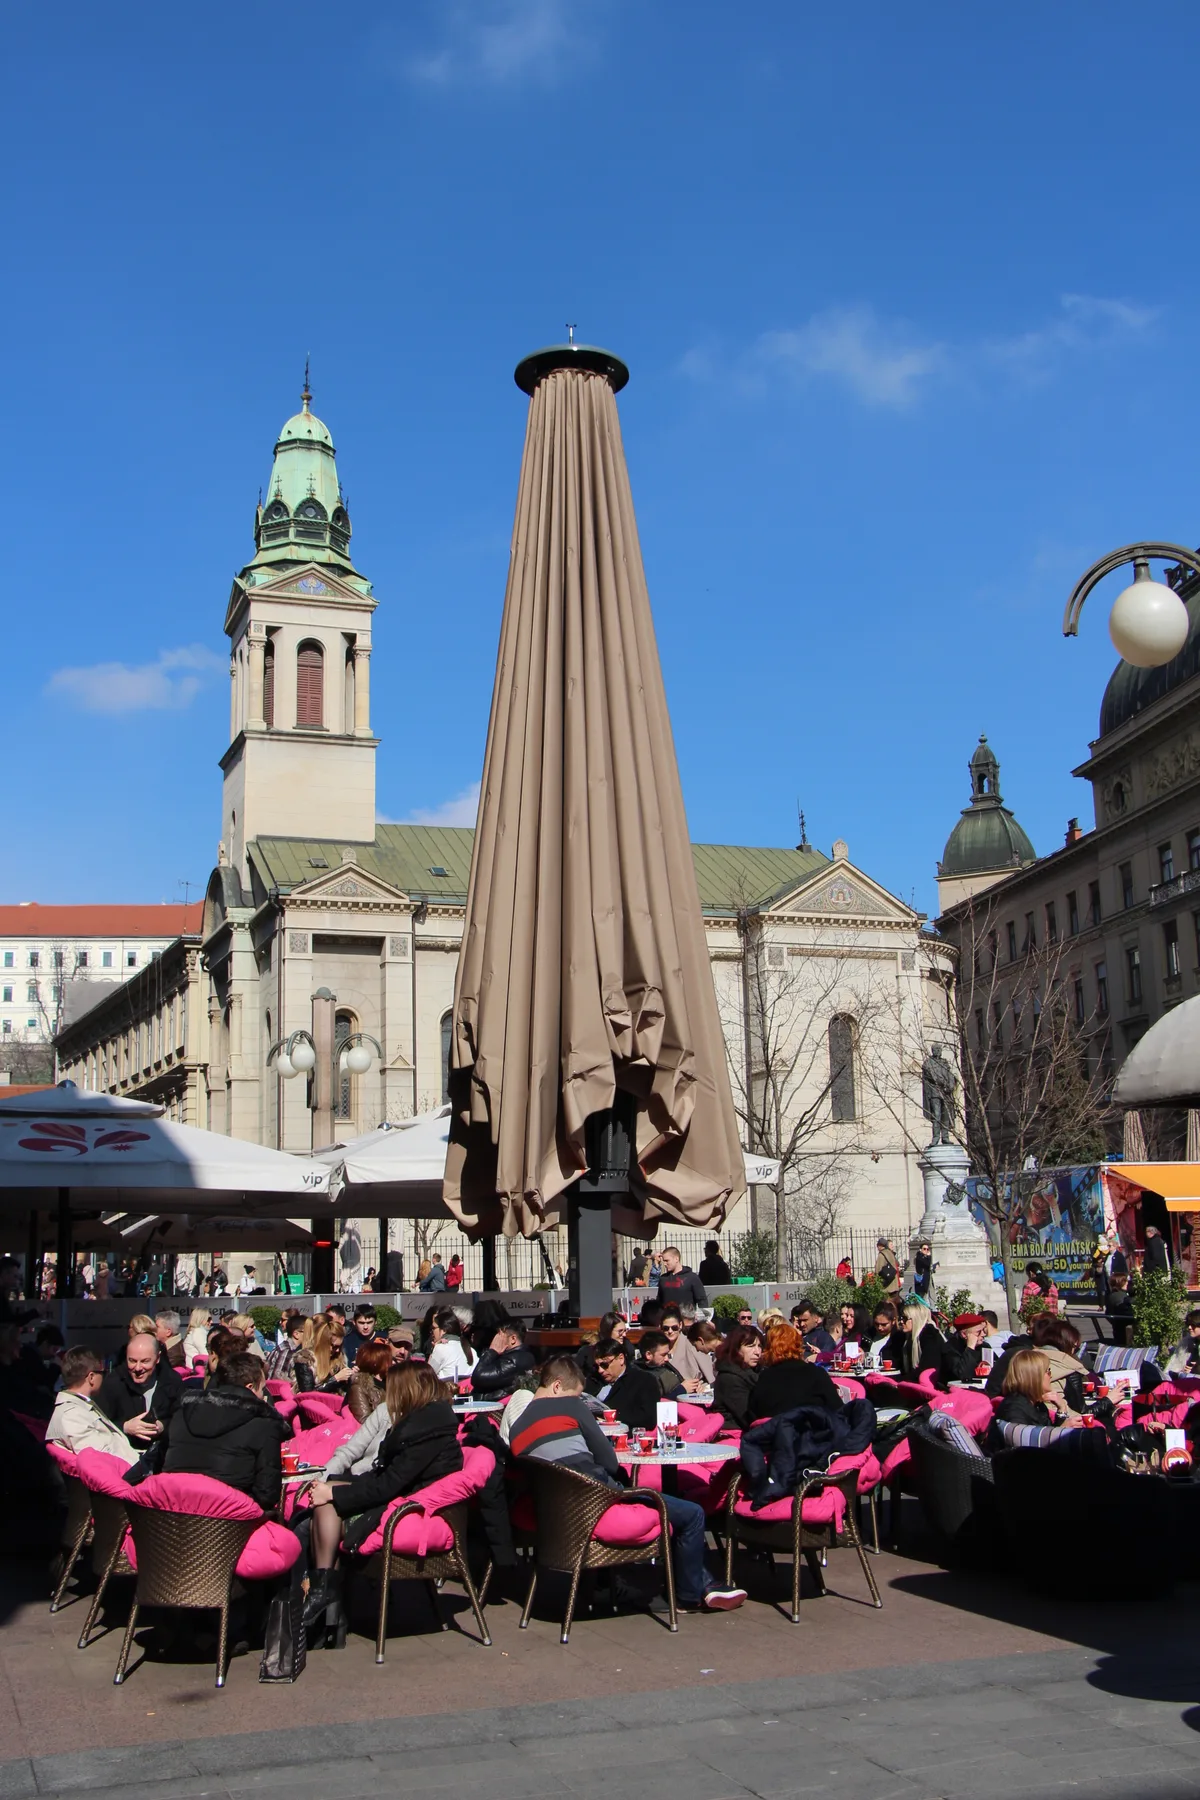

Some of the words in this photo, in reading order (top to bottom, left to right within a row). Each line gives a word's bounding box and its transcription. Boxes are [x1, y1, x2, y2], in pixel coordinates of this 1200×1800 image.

[756, 1165, 773, 1179] vip
[302, 1172, 323, 1187] vip
[1030, 1243, 1046, 1256] BOX
[1046, 1243, 1053, 1256] U
[1012, 1260, 1025, 1271] 4D
[1054, 1259, 1067, 1270] 5D
[1069, 1263, 1081, 1271] you
[1056, 1282, 1070, 1290] you
[1072, 1279, 1096, 1289] involv
